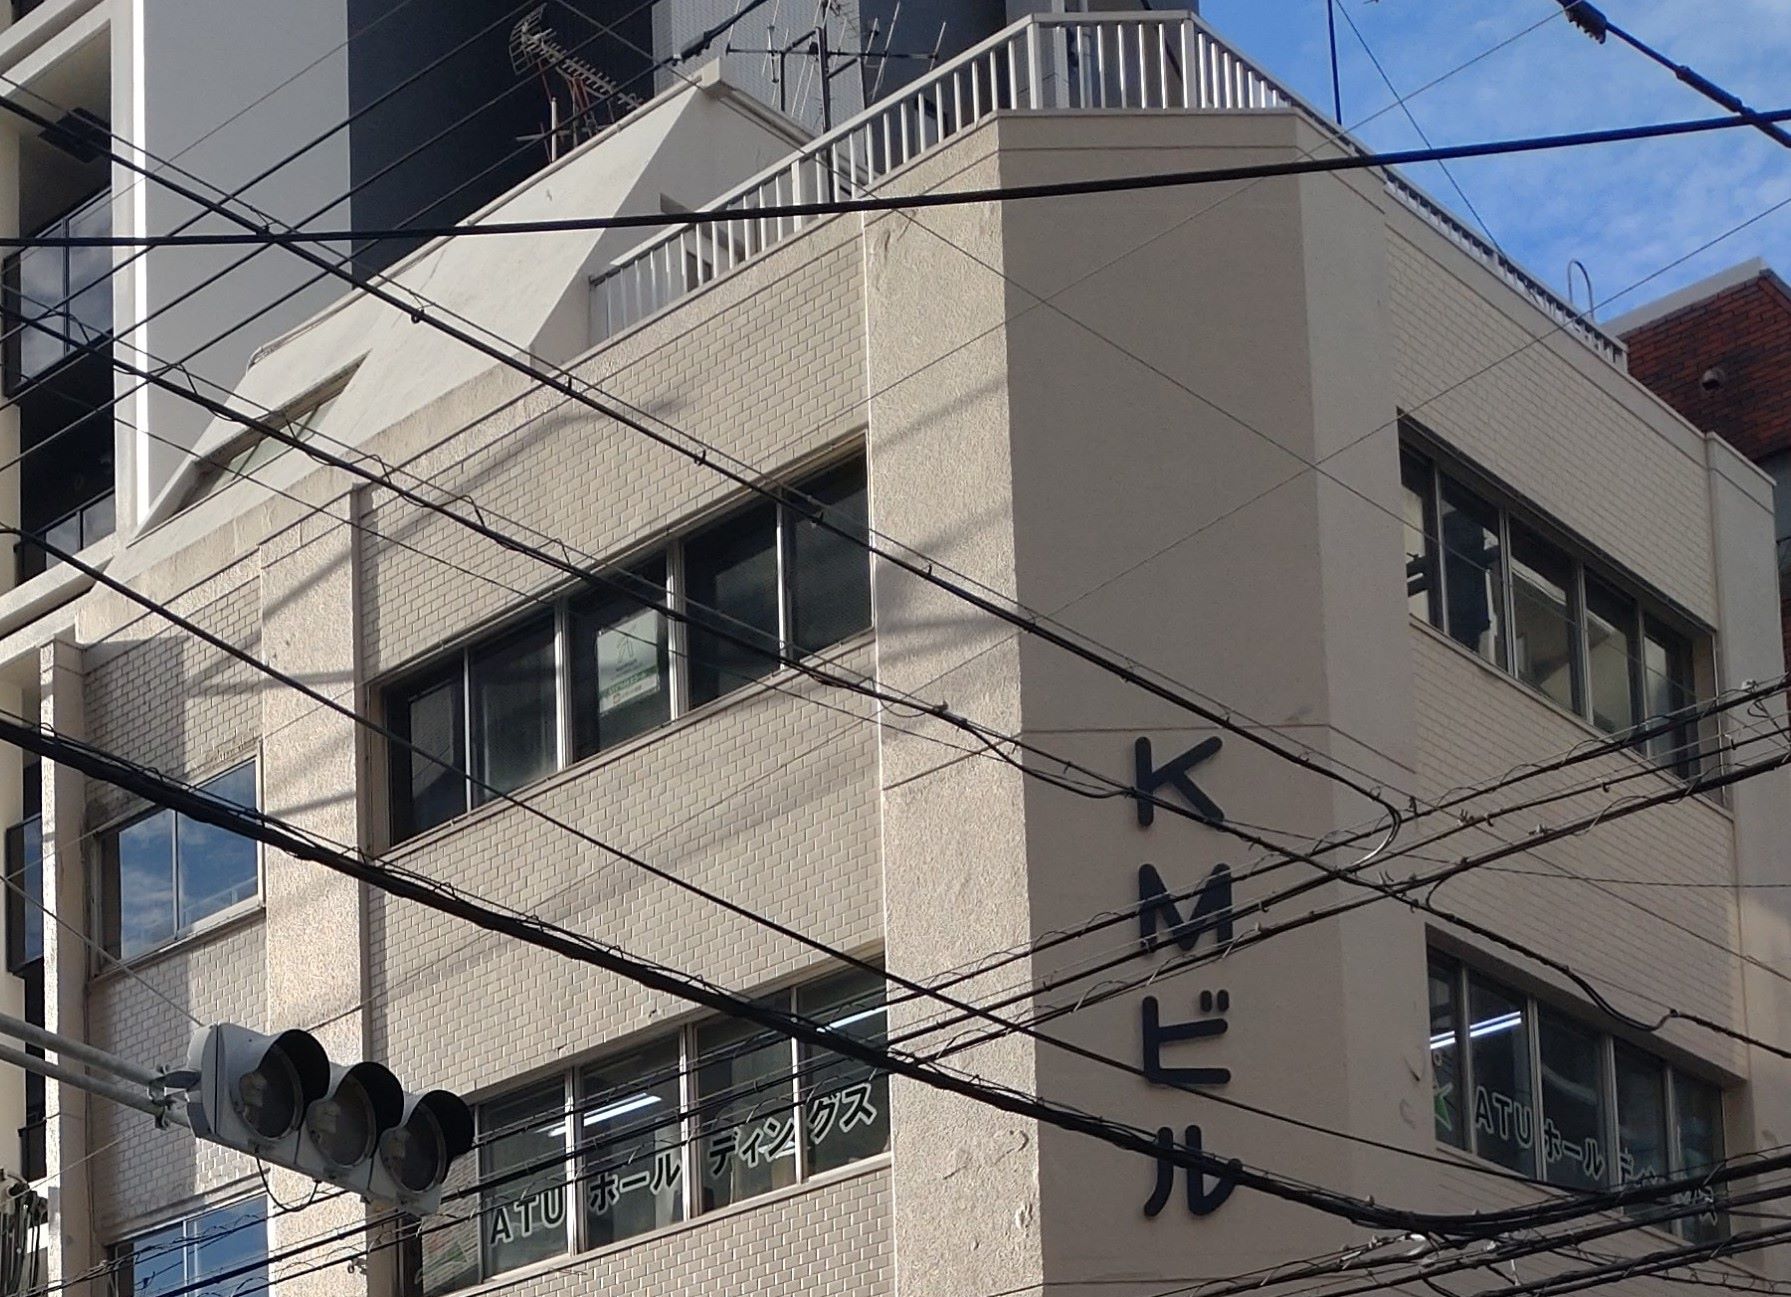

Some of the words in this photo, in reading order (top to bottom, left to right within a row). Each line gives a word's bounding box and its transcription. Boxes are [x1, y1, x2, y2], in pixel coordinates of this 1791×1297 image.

[1134, 736, 1243, 1218] KMビル
[1475, 1085, 1533, 1148] ATU
[489, 1186, 567, 1248] ATU
